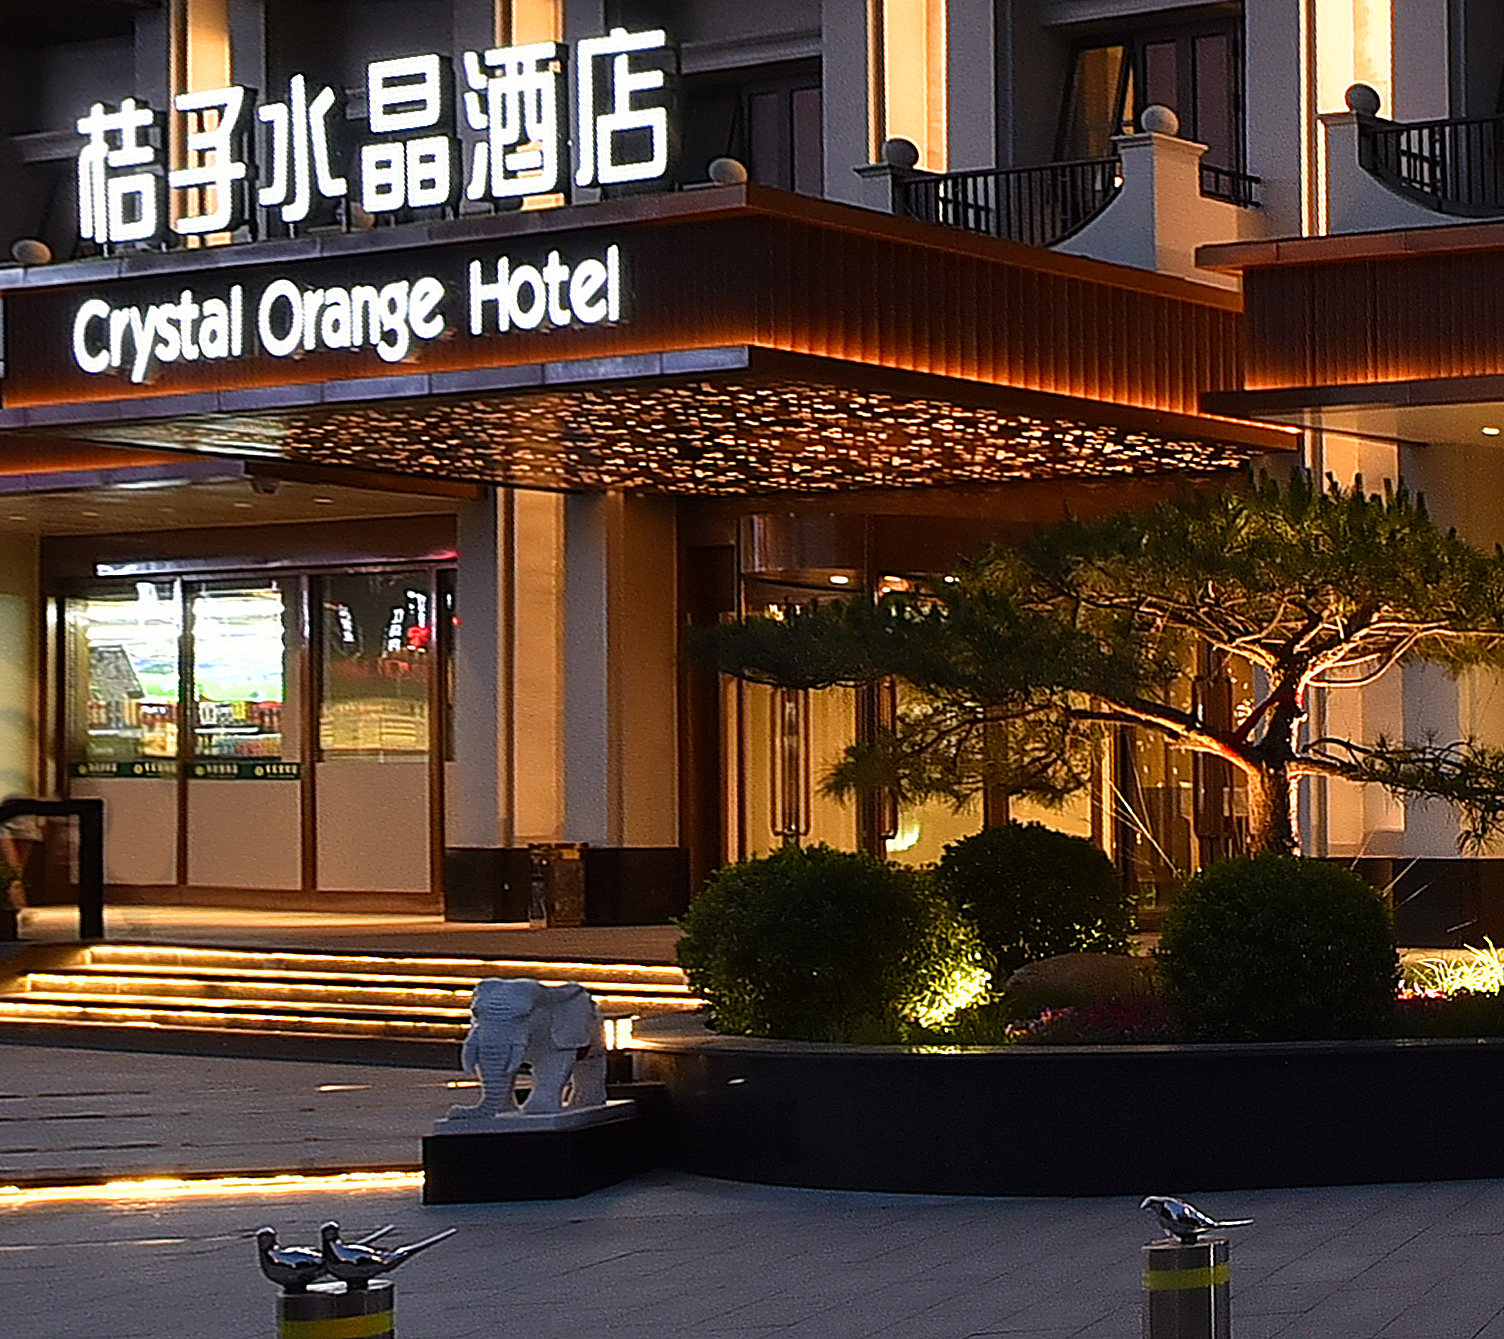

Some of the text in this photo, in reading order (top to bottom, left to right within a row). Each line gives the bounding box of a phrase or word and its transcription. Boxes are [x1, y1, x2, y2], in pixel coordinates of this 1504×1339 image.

[76, 26, 669, 245] 桔子水晶酒店
[72, 243, 621, 384] Crystal Orange Hotel
